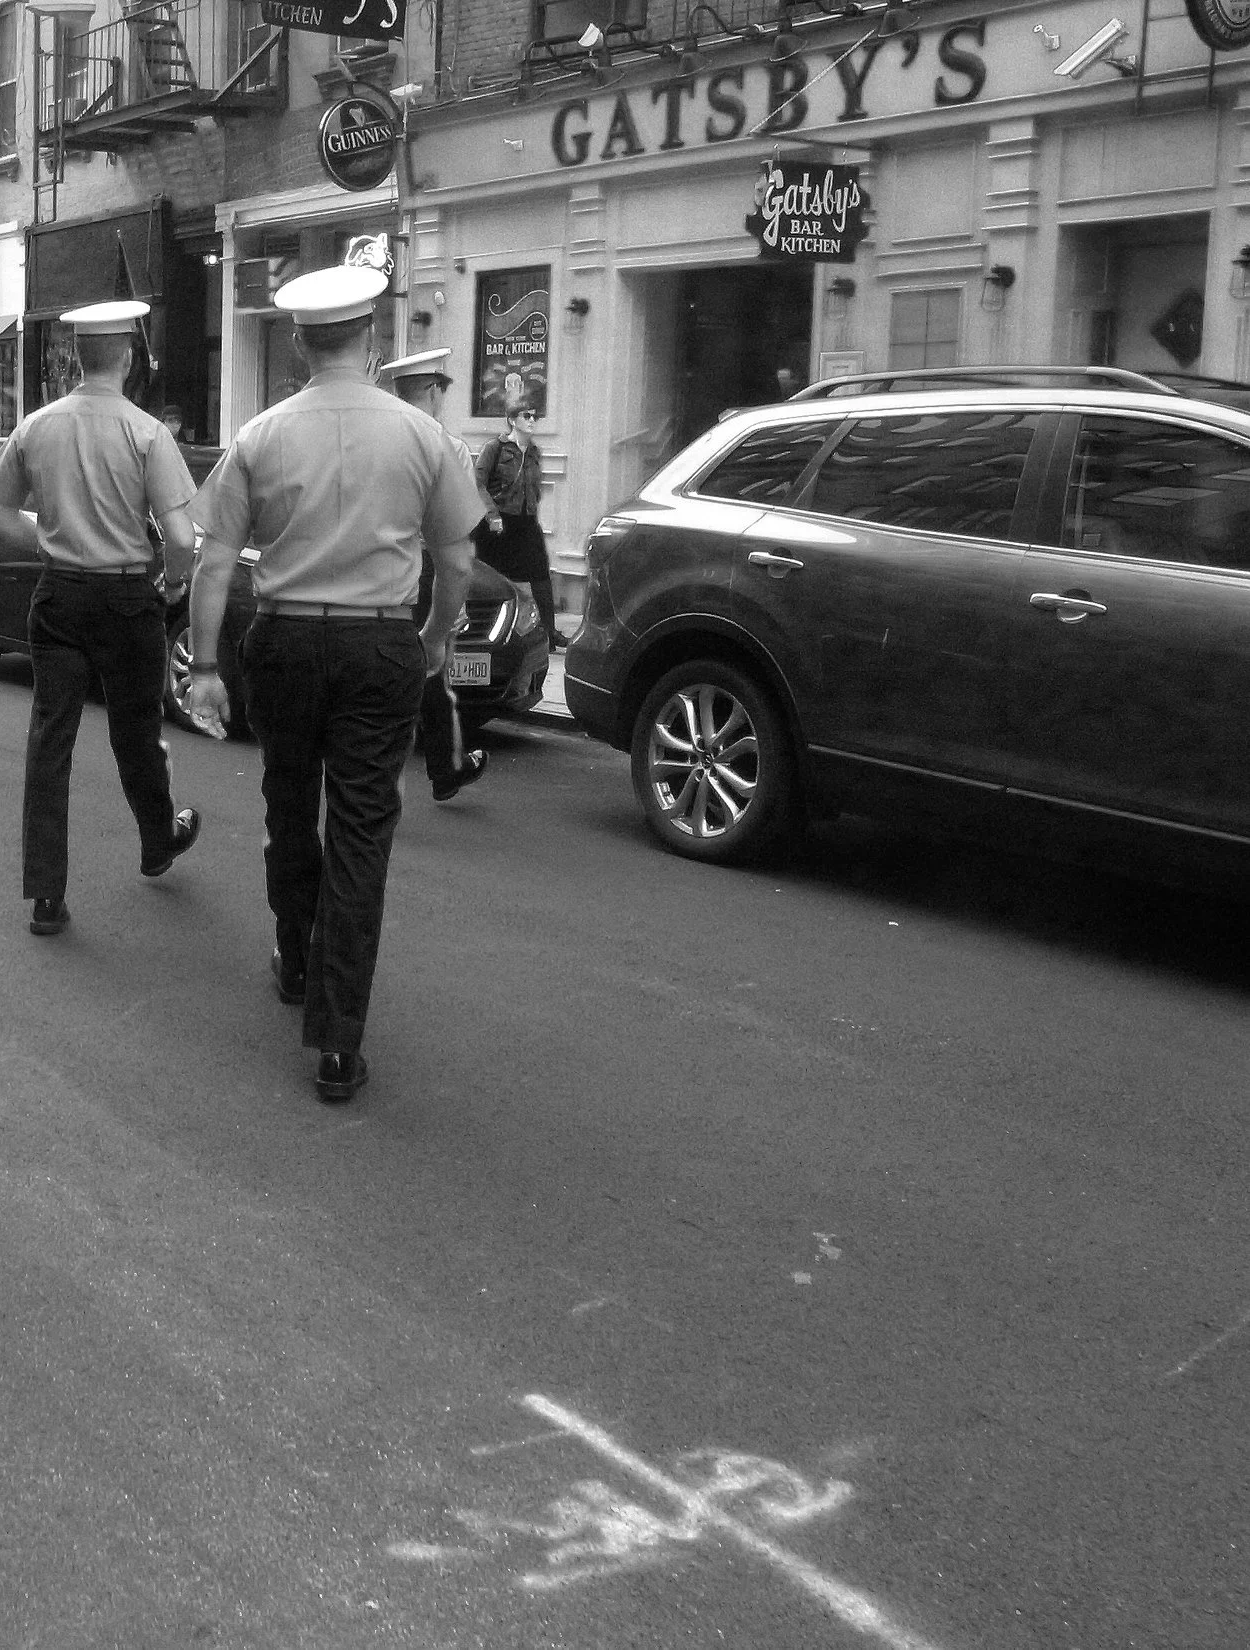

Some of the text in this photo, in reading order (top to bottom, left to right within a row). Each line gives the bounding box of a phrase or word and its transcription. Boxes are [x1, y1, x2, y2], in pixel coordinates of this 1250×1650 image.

[551, 20, 987, 167] GATSBY'S
[328, 125, 392, 152] GUINNESS
[761, 168, 861, 247] Gatsby's
[790, 219, 824, 236] BAR
[781, 236, 841, 254] KITCHEN
[486, 343, 504, 356] BAR
[512, 341, 546, 354] KITCHEN
